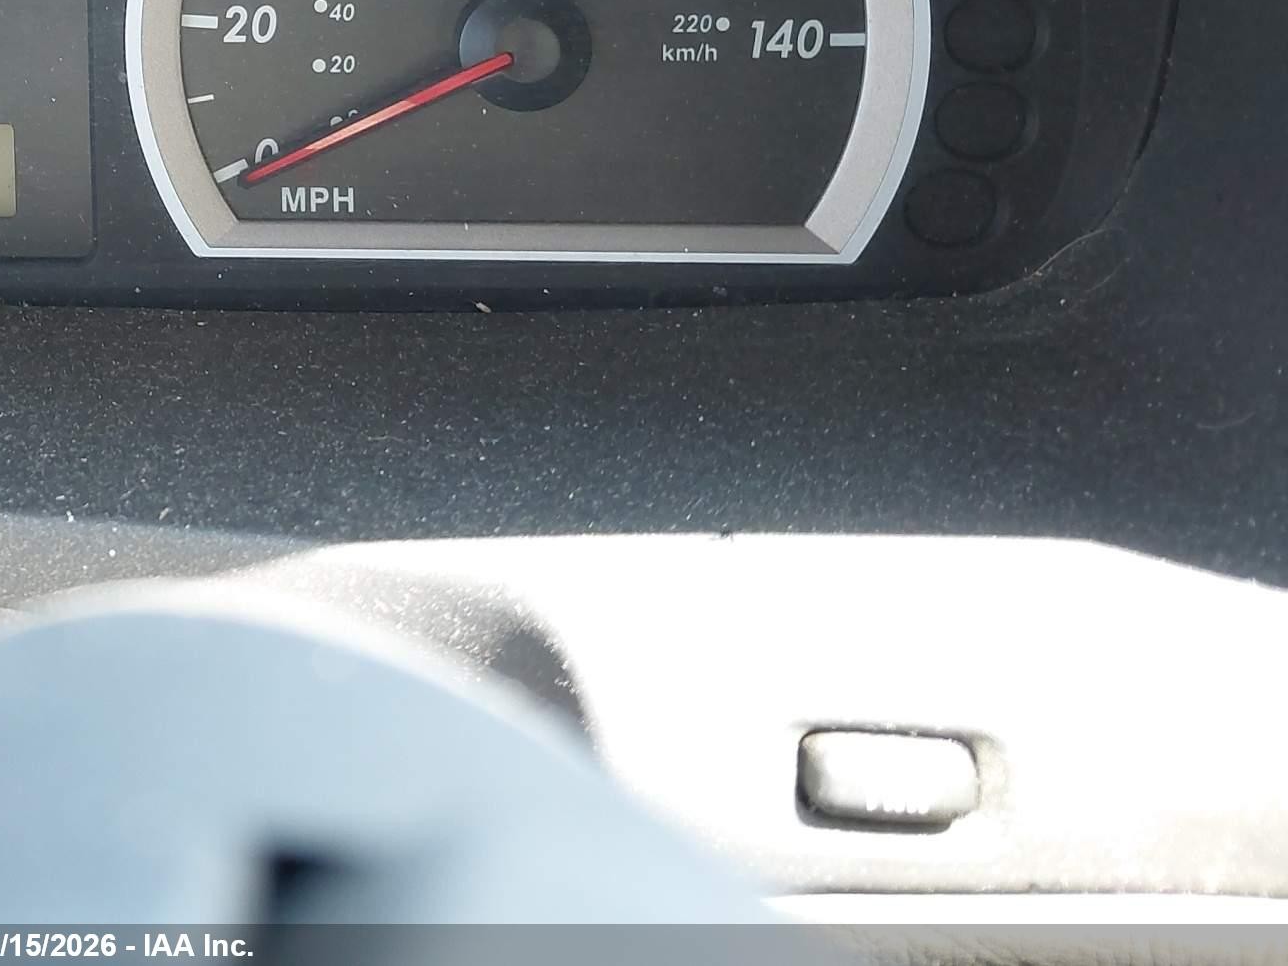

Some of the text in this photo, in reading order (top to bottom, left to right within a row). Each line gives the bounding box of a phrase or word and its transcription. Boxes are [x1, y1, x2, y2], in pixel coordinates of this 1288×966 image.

[329, 3, 355, 22] 40
[223, 4, 277, 44] 20
[672, 14, 713, 33] 220
[751, 19, 824, 59] 140
[662, 43, 718, 62] km/h
[329, 55, 355, 74] 20
[281, 186, 354, 213] MPH
